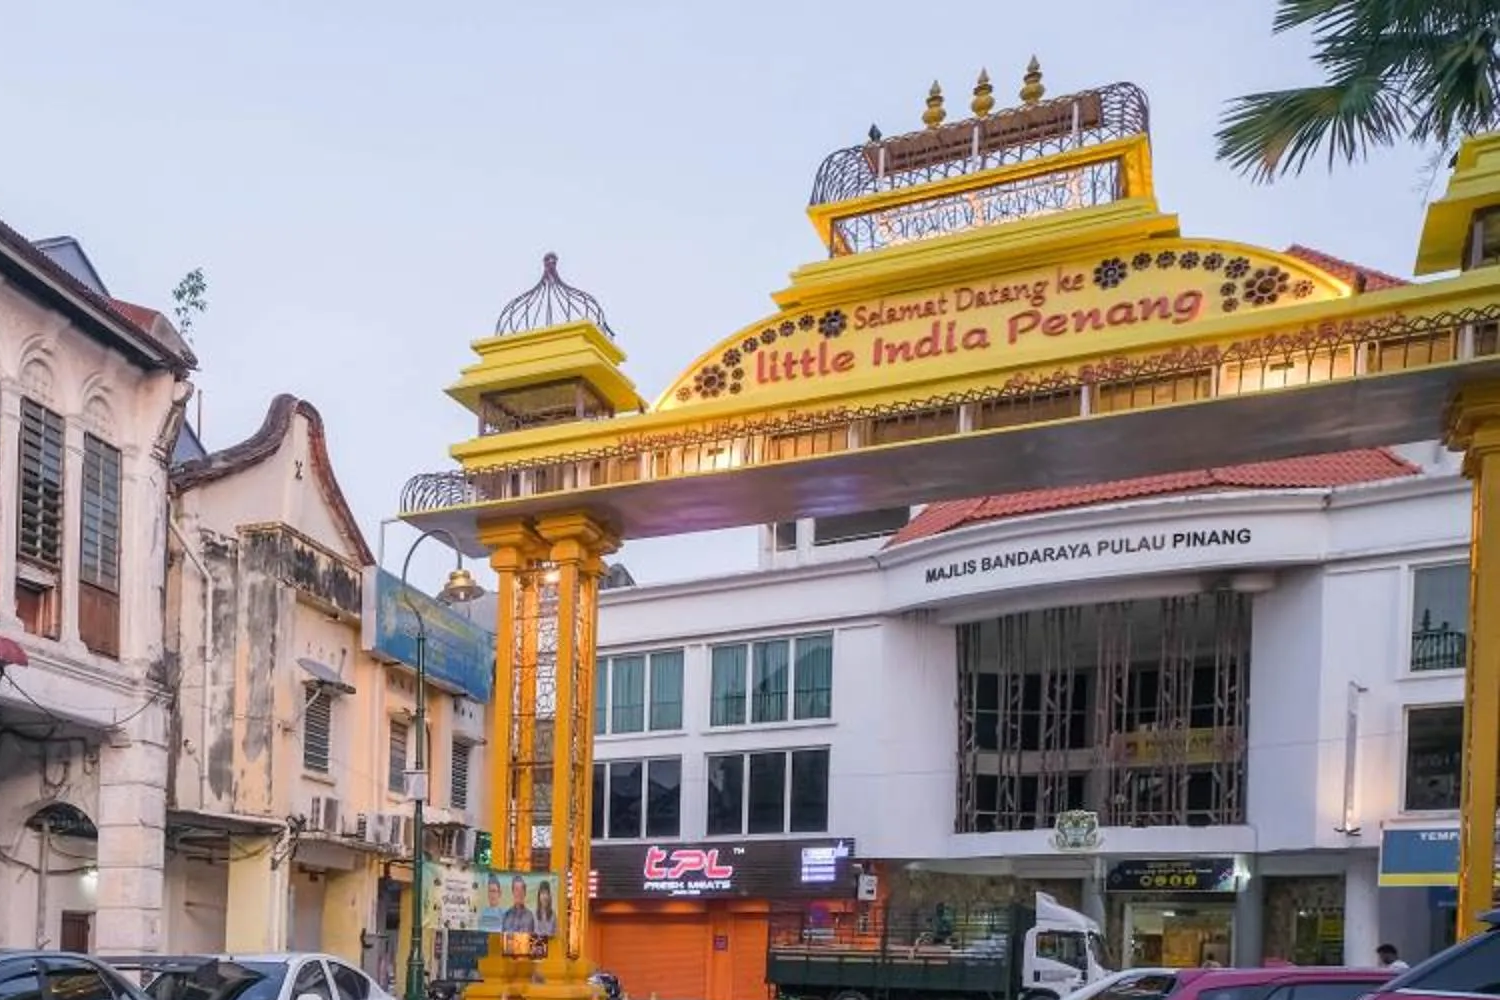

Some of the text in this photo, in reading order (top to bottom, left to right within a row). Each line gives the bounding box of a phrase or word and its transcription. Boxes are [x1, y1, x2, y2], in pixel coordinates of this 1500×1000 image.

[853, 267, 1085, 332] Selamat Datang ke
[872, 321, 990, 367] India
[1008, 289, 1204, 345] Penang
[925, 527, 1252, 583] MAJLIS BANDARAYA PULAU PINANG
[1420, 831, 1460, 841] TEMP
